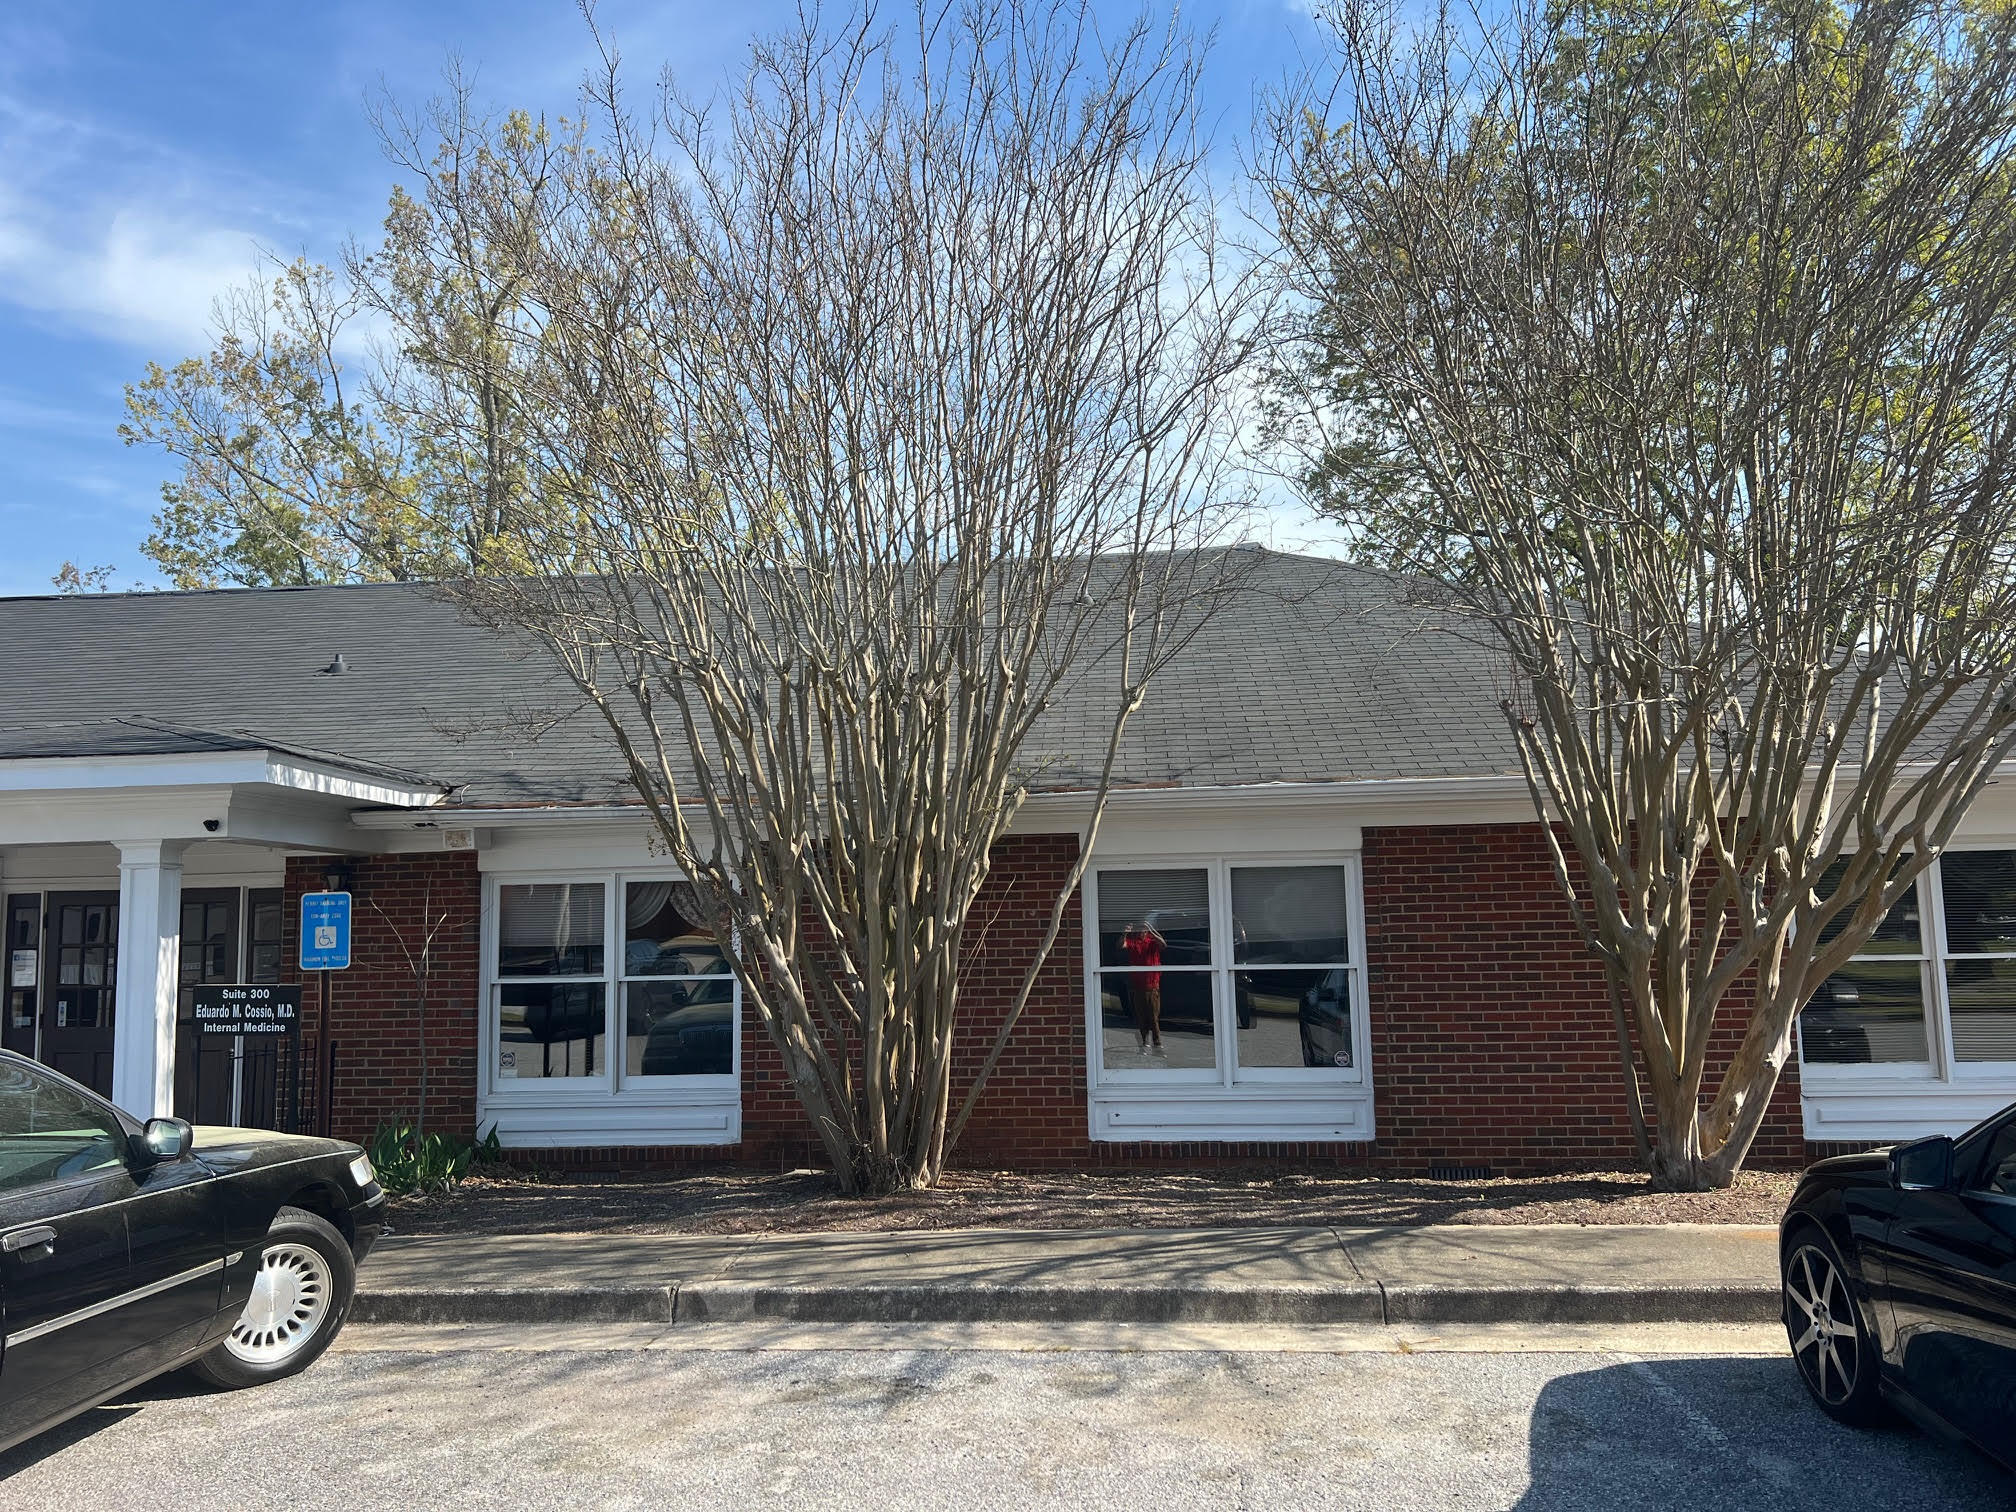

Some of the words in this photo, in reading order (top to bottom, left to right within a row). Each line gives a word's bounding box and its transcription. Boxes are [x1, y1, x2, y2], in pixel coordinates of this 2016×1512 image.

[222, 989, 247, 999] Suite
[250, 989, 270, 999] 300
[196, 1004, 229, 1018] Eduardo
[232, 1004, 242, 1018] M.
[245, 1004, 275, 1021] Cossio,
[277, 1004, 295, 1018] M.D.
[204, 1022, 240, 1032] Internal
[243, 1022, 286, 1032] Medicine
